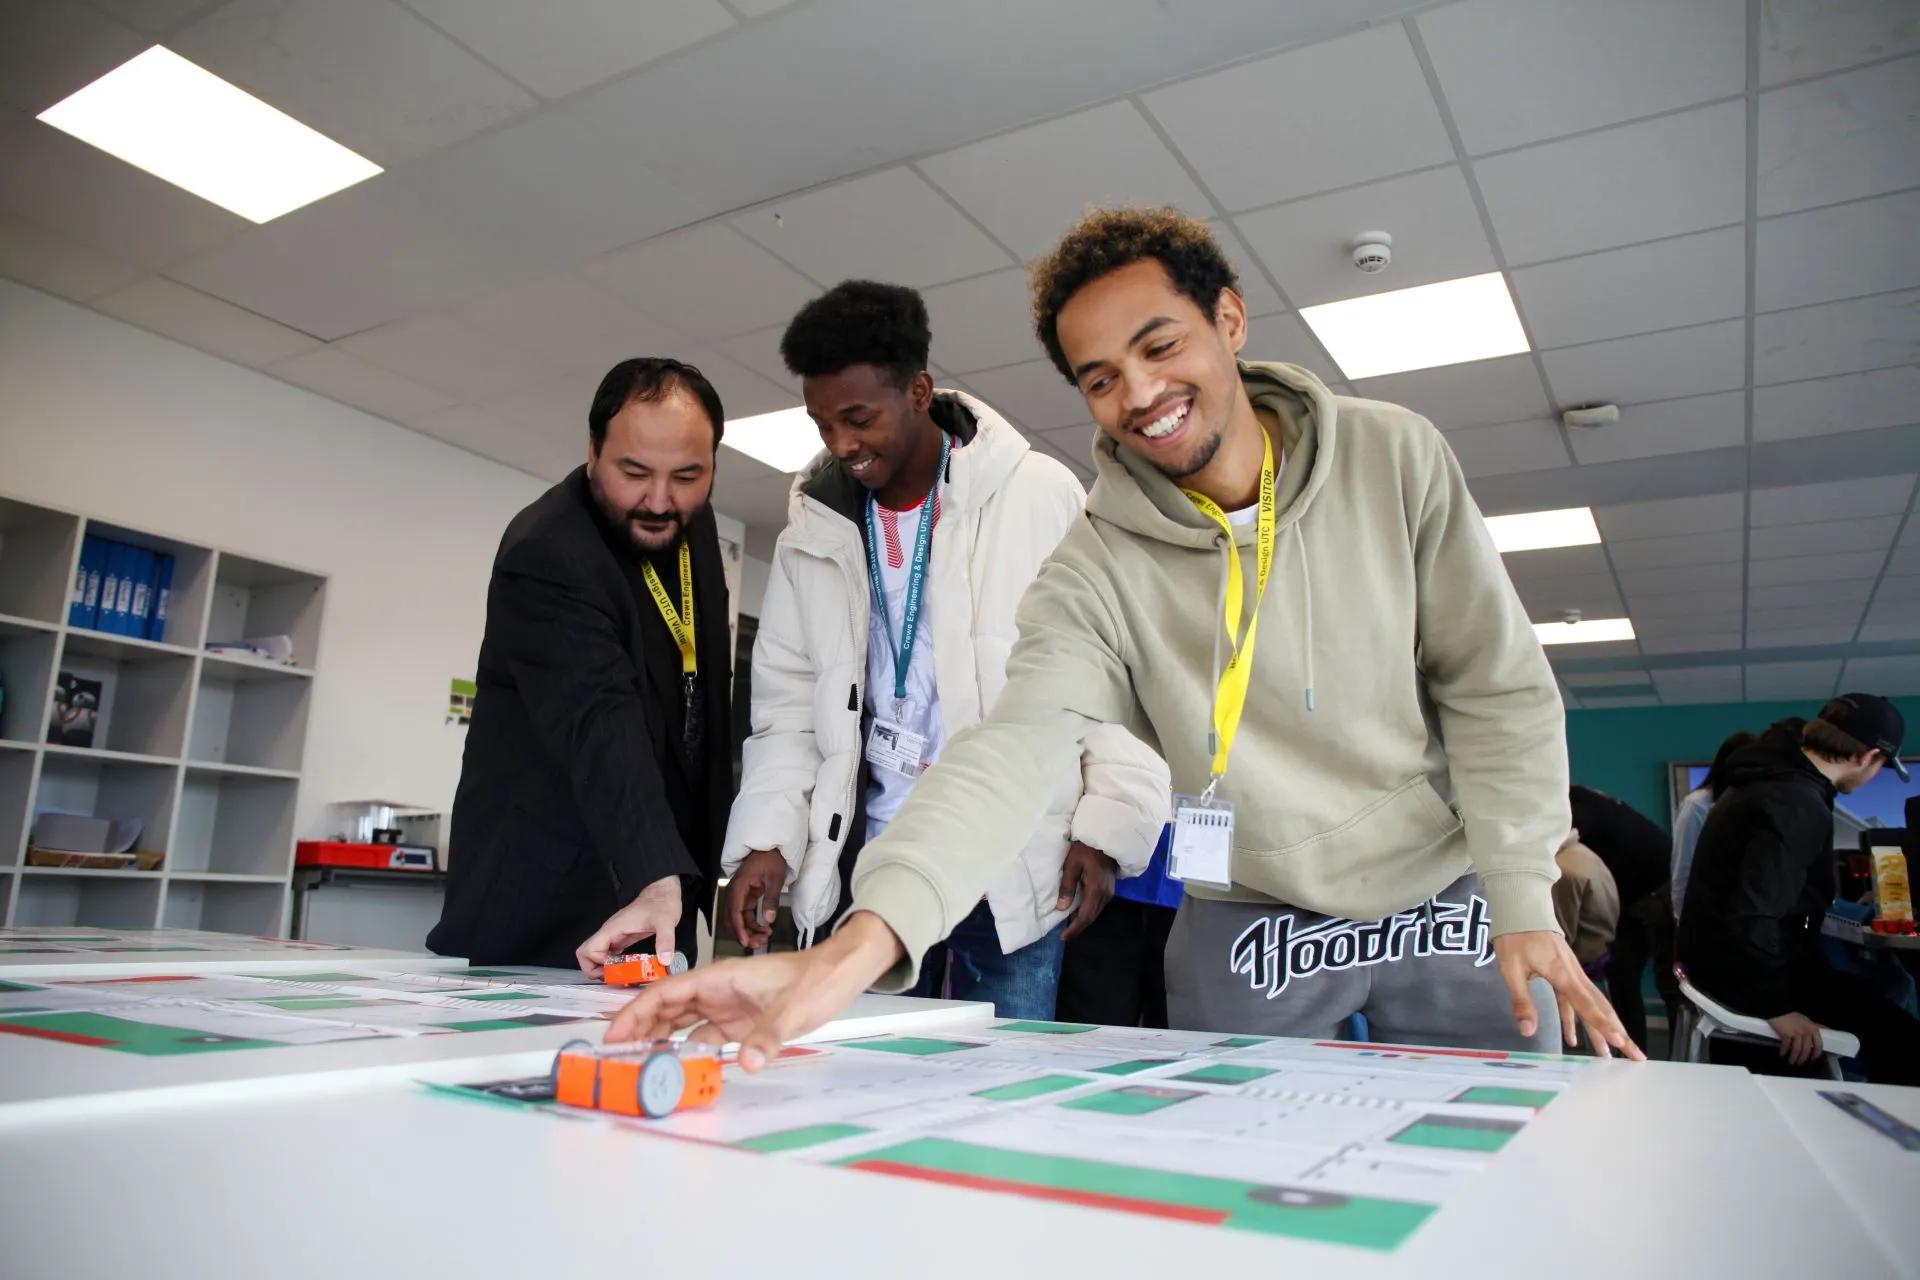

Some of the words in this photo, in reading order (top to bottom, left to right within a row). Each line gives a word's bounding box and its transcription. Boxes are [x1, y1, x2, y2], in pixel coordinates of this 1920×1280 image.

[1262, 469, 1272, 513] VISITOR
[919, 515, 929, 534] UTC
[1261, 527, 1270, 544] UTC
[915, 535, 928, 563] Design
[1260, 546, 1269, 577] Design
[681, 547, 691, 598] Engineering
[645, 567, 662, 597] Design
[659, 597, 674, 616] UTC
[671, 620, 687, 645] Visitor
[907, 572, 922, 622] Engineering
[683, 599, 691, 626] Crewe
[904, 624, 913, 650] Crewe
